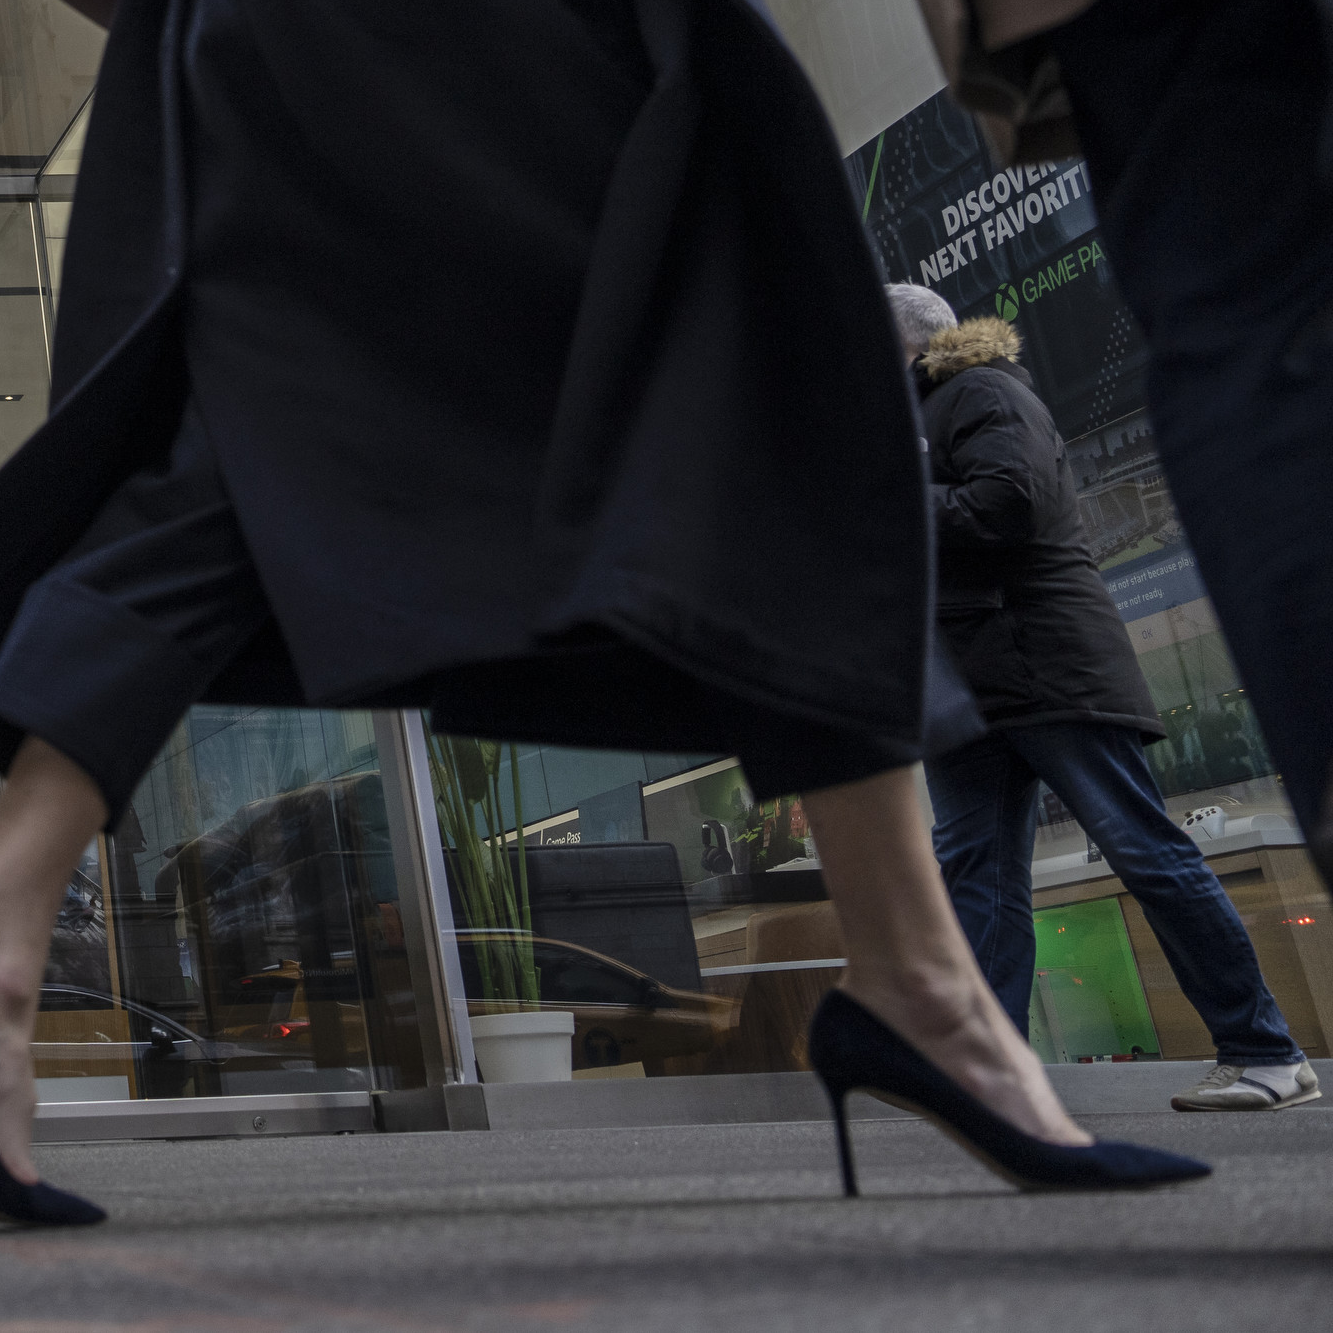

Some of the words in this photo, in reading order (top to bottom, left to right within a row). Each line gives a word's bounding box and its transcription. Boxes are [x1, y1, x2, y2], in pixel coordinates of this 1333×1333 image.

[919, 228, 979, 287] NEXT
[1021, 253, 1079, 304] GAME
[1141, 627, 1153, 640] OK
